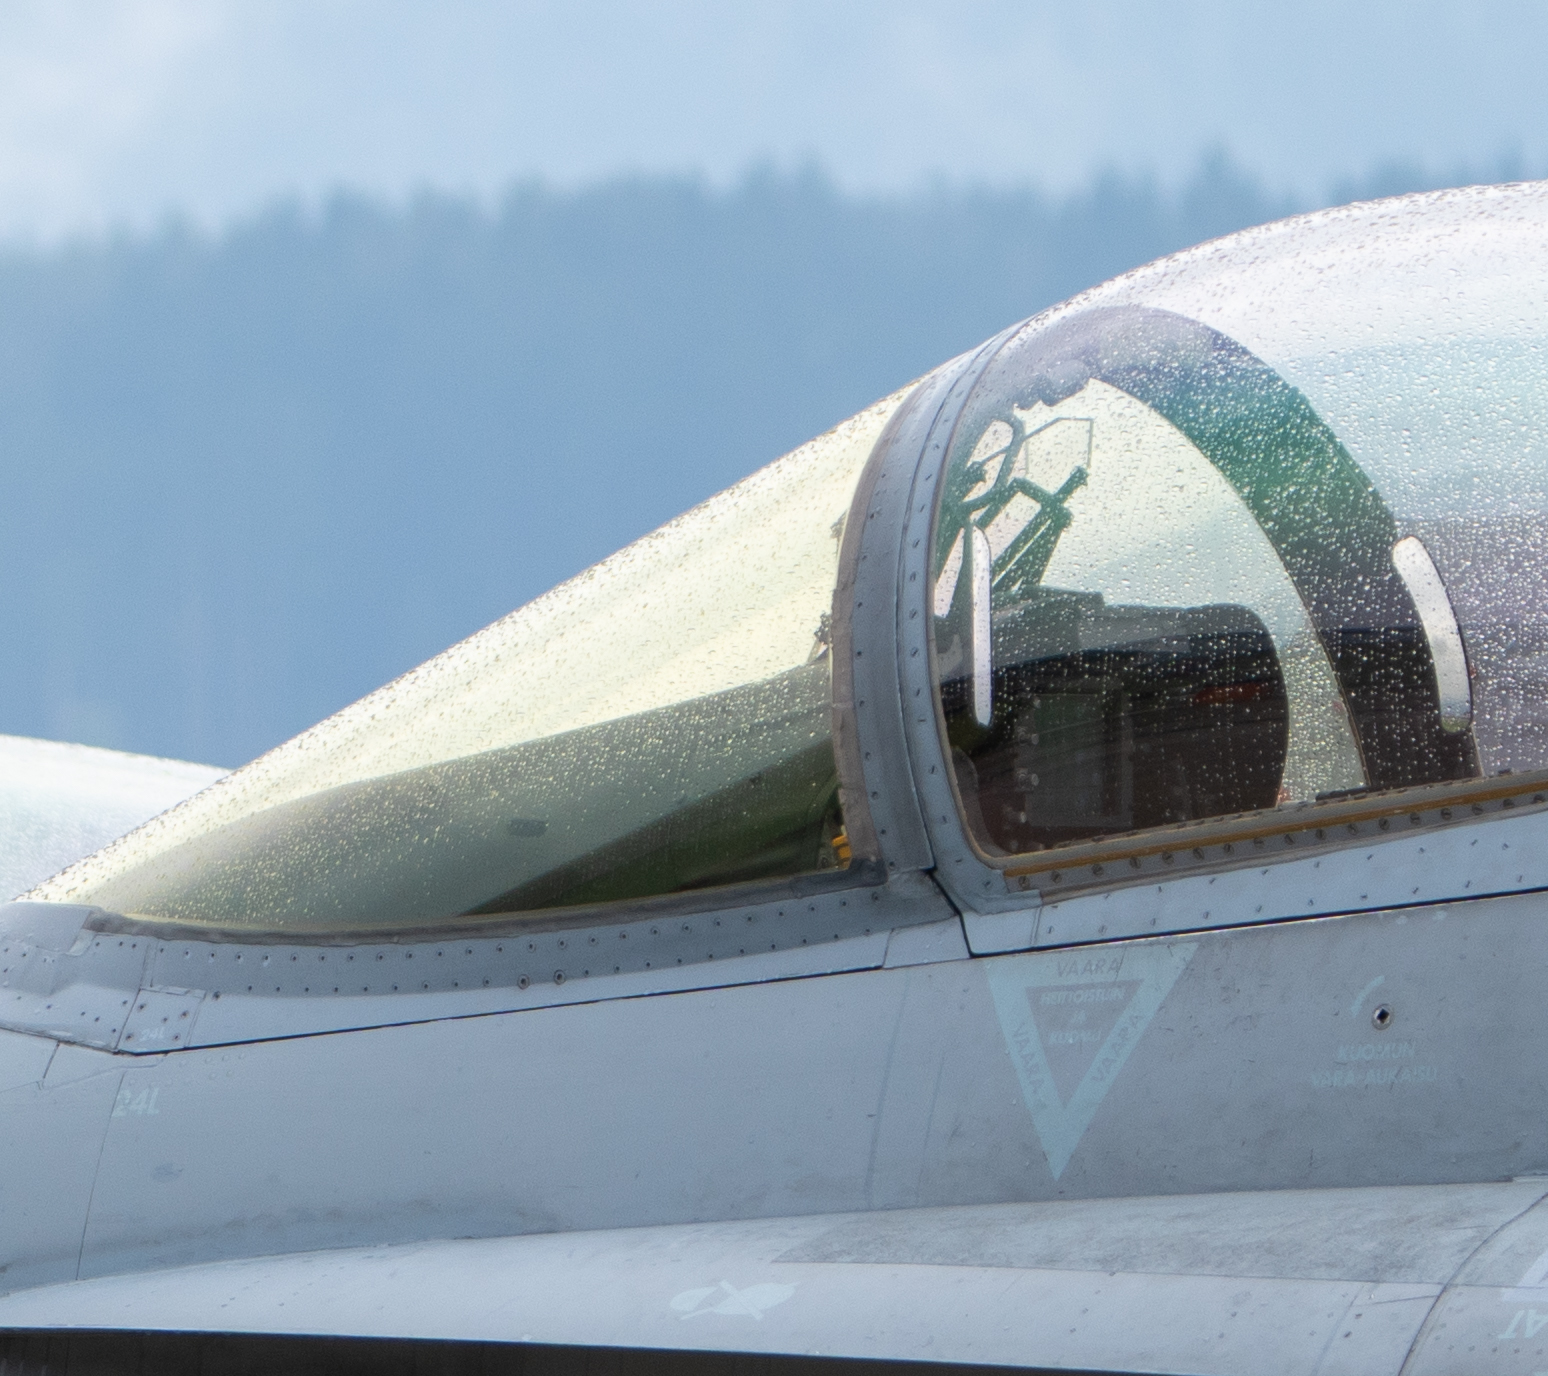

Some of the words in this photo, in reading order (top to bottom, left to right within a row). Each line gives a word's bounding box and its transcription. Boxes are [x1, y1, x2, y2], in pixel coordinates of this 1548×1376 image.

[1056, 957, 1121, 978] VAARA
[1012, 1021, 1046, 1096] VAARA
[1091, 1013, 1144, 1083] VAARA
[112, 1087, 160, 1118] 24L
